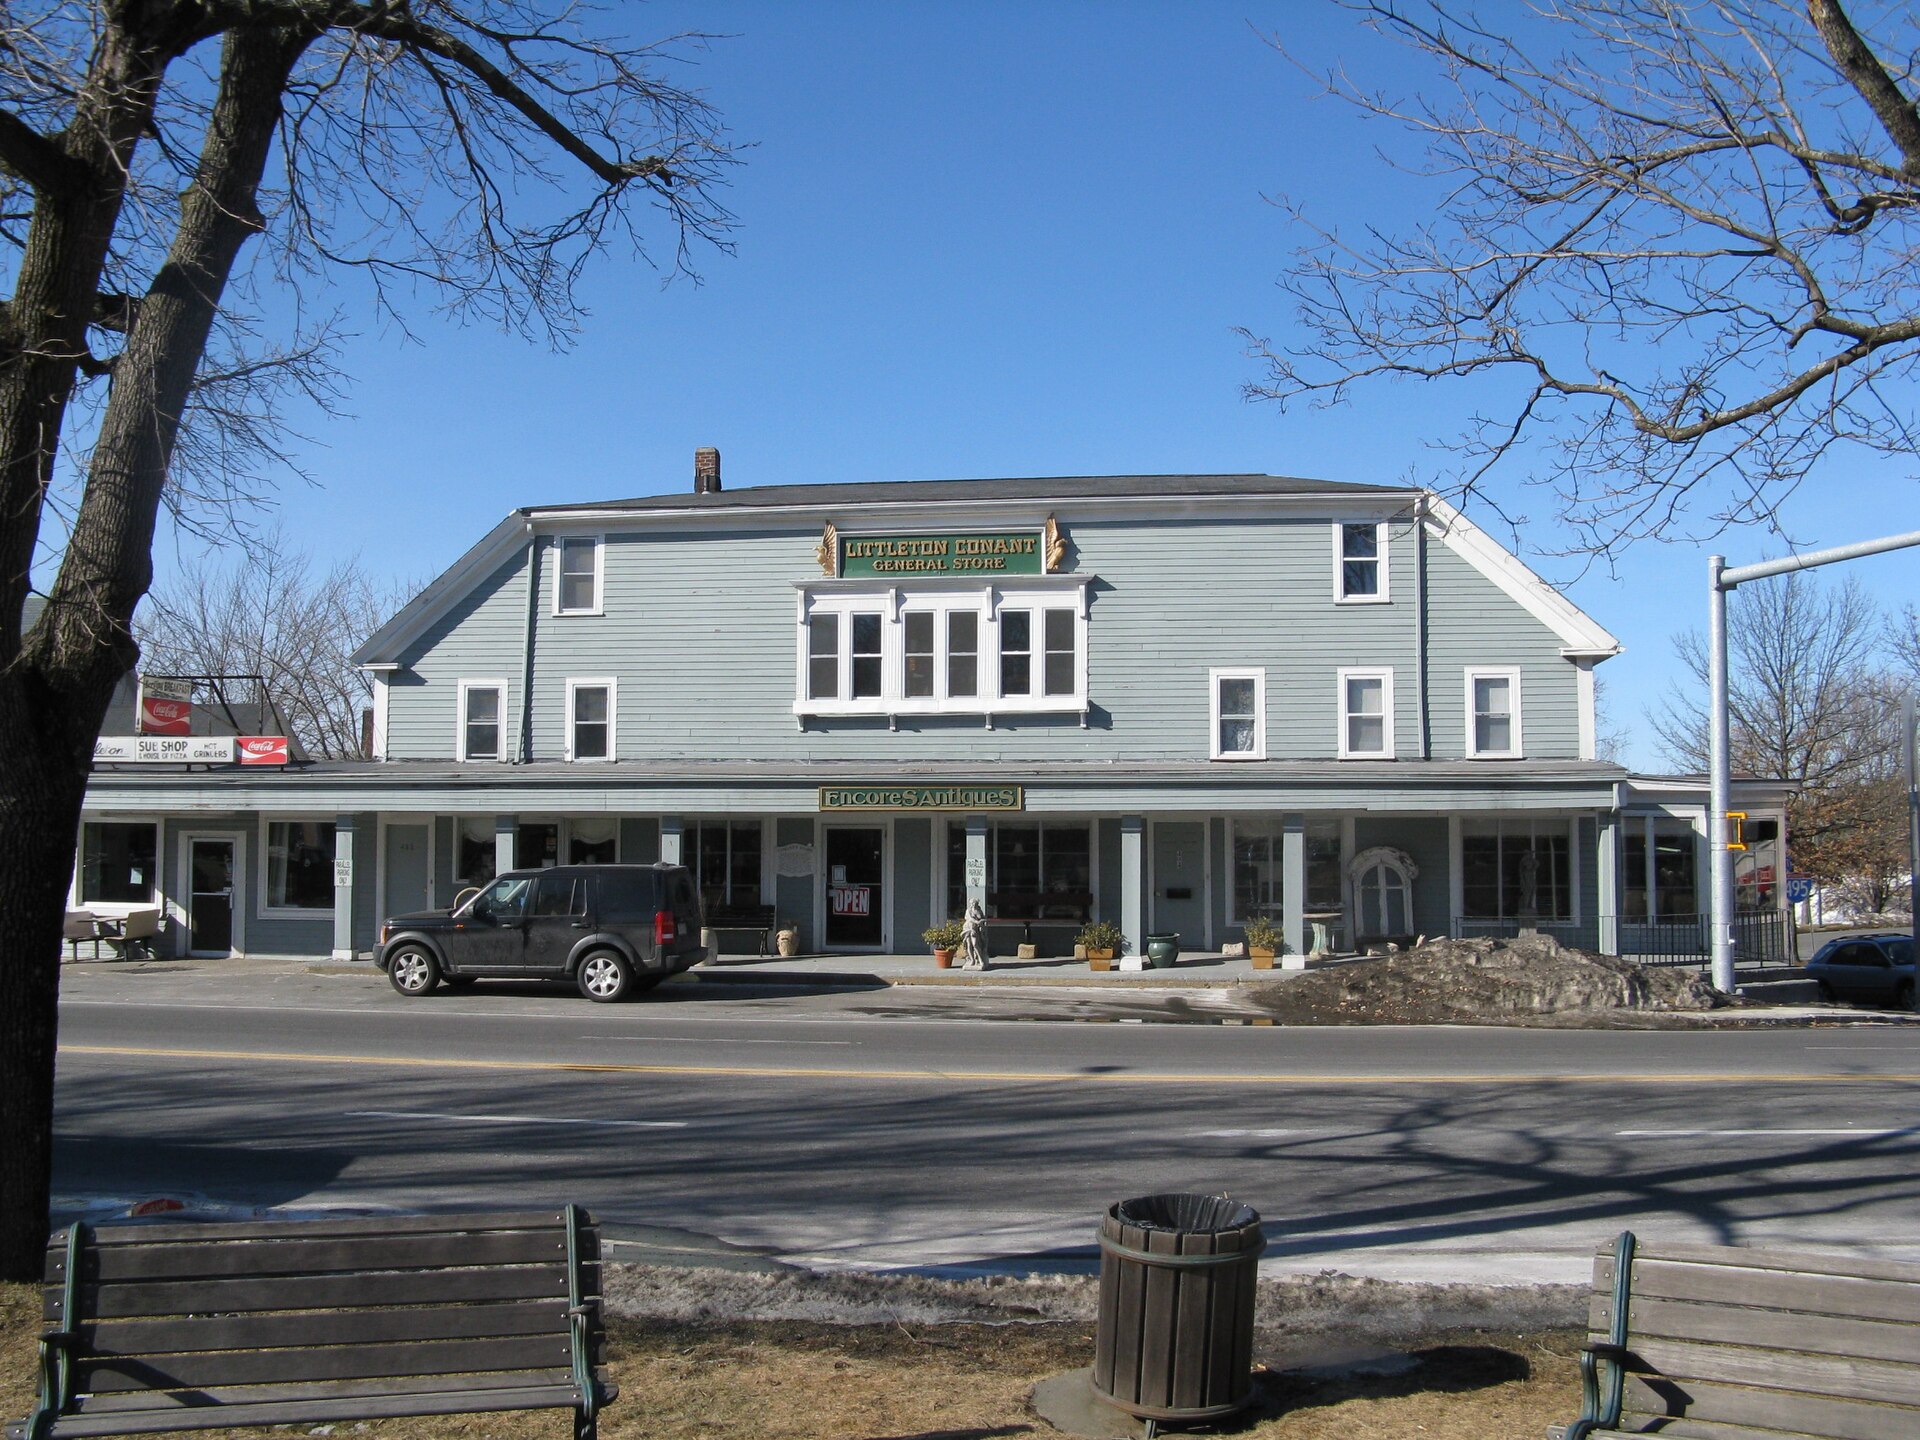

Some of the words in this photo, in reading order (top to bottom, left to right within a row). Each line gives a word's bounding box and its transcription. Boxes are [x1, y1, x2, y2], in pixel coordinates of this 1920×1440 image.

[846, 540, 949, 558] LITTLETON
[954, 538, 1036, 555] CONANT
[872, 559, 948, 572] GENERAL
[953, 557, 1006, 570] STORE
[139, 741, 158, 752] SUB
[161, 741, 189, 752] SHOP
[247, 740, 275, 752] Coca-Cola
[193, 750, 228, 758] GRINDERS
[1787, 880, 1808, 897] 495
[834, 889, 868, 912] OPEN
